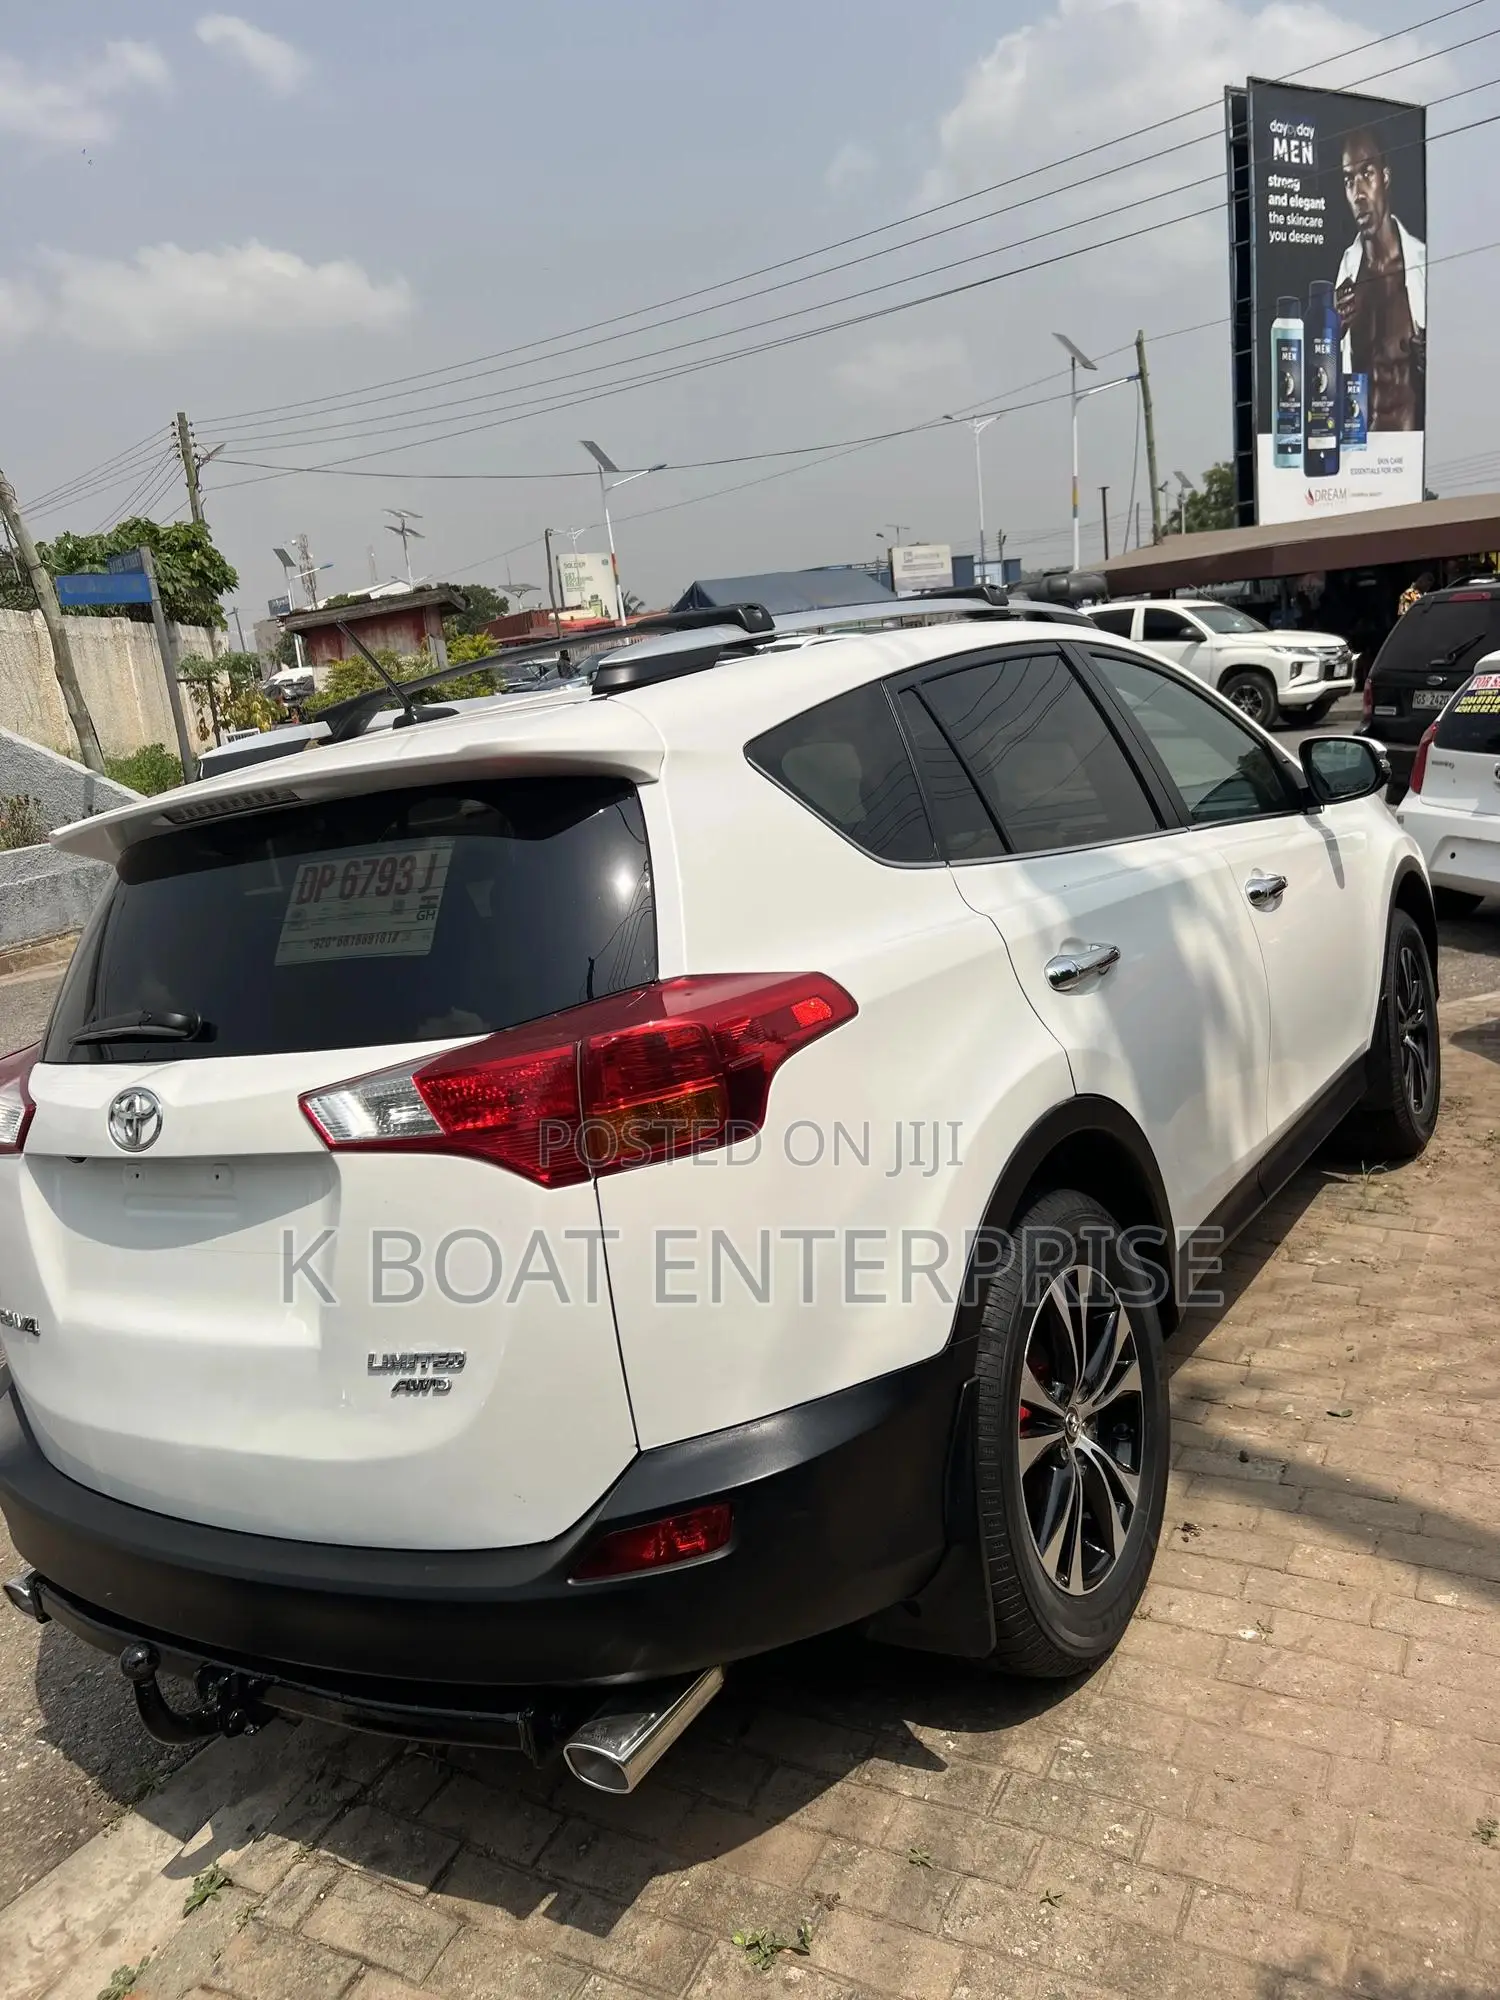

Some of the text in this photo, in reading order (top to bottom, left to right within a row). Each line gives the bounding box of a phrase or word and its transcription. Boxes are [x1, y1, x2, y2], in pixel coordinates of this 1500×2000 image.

[1273, 137, 1314, 164] MEN
[1267, 174, 1301, 192] strong
[1267, 193, 1326, 211] and elegant
[1268, 211, 1324, 228] the skincare
[1268, 229, 1324, 245] you deserve
[1281, 352, 1297, 360] MEN
[1314, 344, 1331, 354] MEN
[1347, 385, 1360, 394] MEN
[1314, 487, 1347, 502] DREAM
[295, 865, 337, 905] DP
[339, 854, 417, 900] 6793
[416, 910, 436, 921] GH
[367, 1351, 466, 1375] LIMITED
[391, 1377, 453, 1397] AWD
